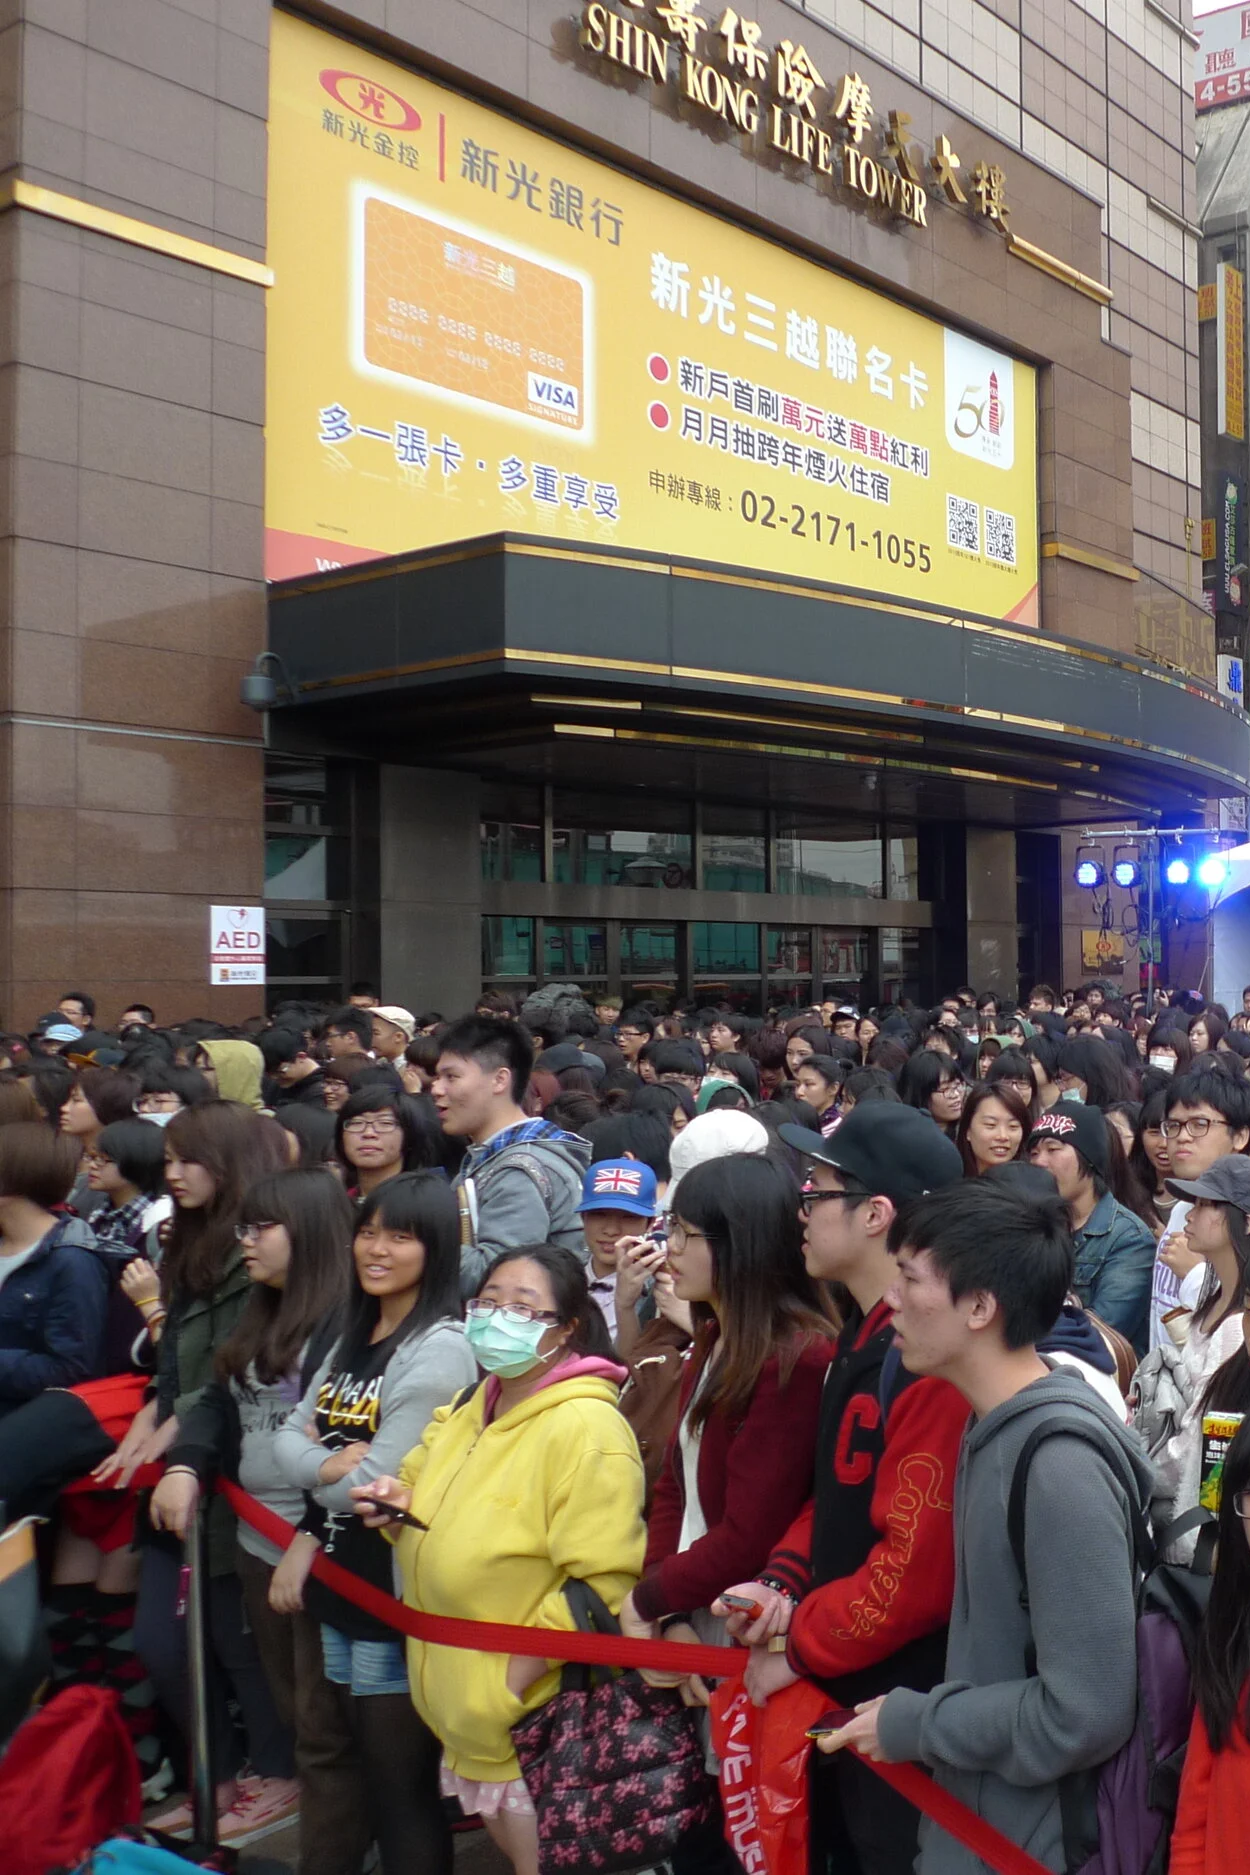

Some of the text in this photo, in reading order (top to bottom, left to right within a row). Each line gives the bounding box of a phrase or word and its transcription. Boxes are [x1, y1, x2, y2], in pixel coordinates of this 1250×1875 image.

[321, 108, 420, 171] 新光金控
[586, 3, 928, 228] SHIN KONG LIFE TOWER
[460, 138, 624, 246] 新光銀行
[649, 252, 930, 413] 新光三越聯名卡
[533, 377, 576, 409] VISA
[679, 358, 930, 478] 新戶首刷萬元送萬點紅利
[681, 407, 891, 504] 月月抽跨年煙火住宿
[740, 488, 932, 576] 02-2171-1055
[216, 931, 261, 949] AED
